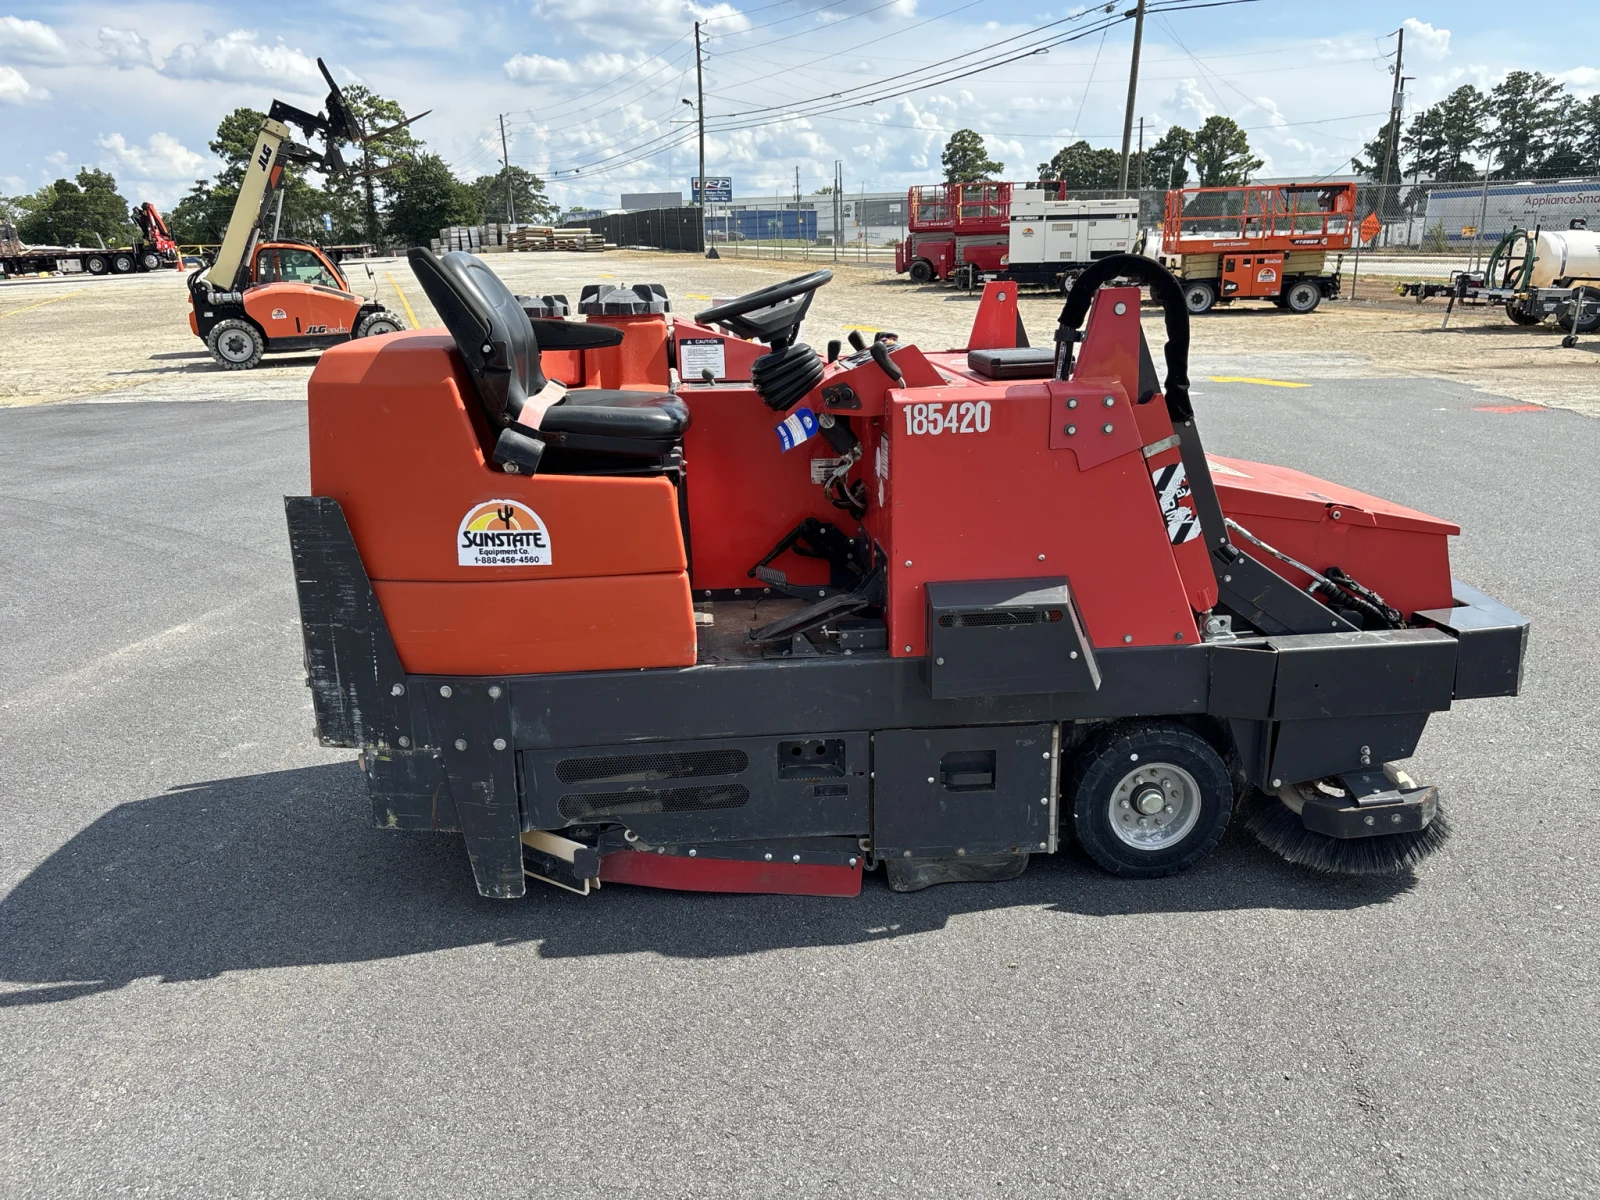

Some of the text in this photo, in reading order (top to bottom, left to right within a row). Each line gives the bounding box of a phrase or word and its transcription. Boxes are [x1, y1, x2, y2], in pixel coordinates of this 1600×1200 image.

[258, 143, 273, 172] JLG
[305, 325, 327, 333] JLG
[903, 400, 992, 436] 185420
[1159, 490, 1180, 525] ARM
[461, 530, 547, 549] SUNSTATE
[474, 556, 540, 564] 1-888-456-4560
[478, 548, 518, 556] Equipment
